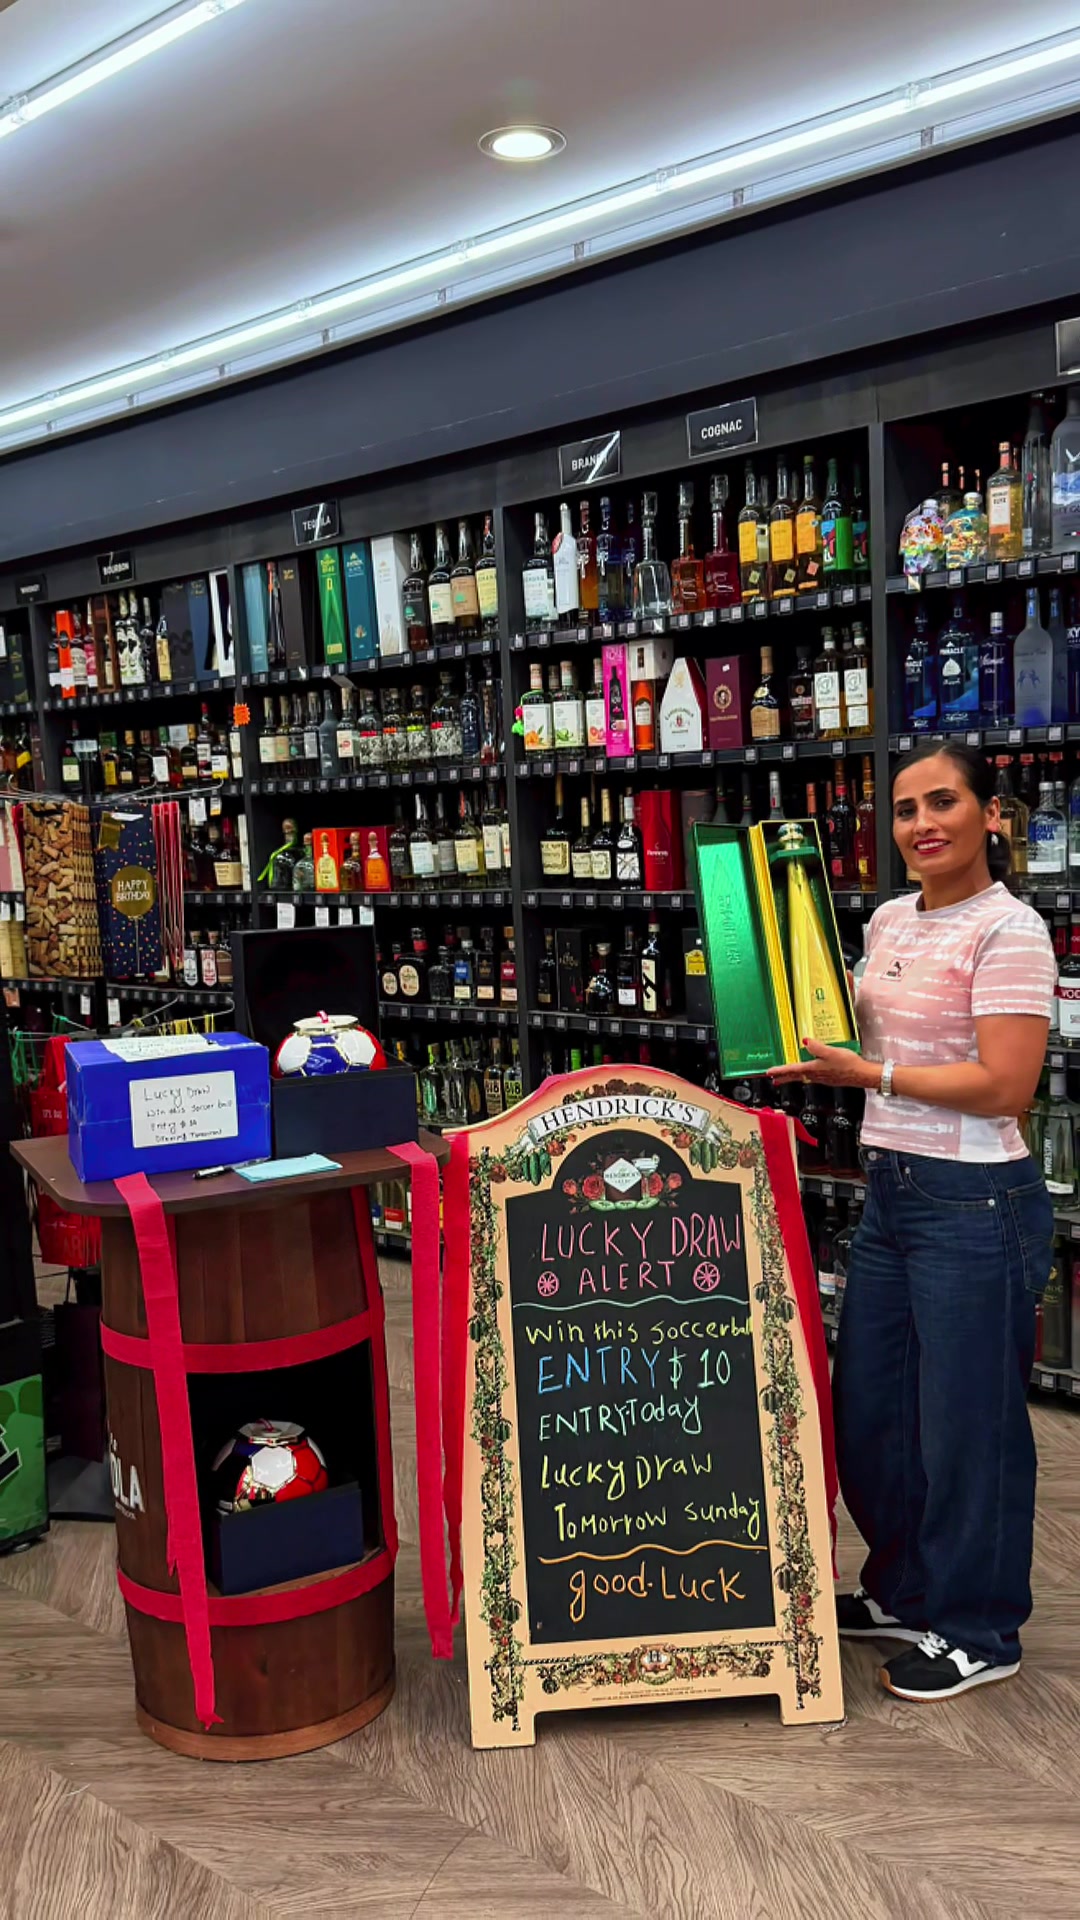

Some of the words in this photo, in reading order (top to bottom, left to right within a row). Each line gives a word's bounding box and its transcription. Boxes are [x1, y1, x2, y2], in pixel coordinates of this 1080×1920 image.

[700, 418, 743, 440] COGNAC
[117, 879, 148, 892] HAPPY
[540, 1098, 698, 1132] HENDRICK'S
[541, 1219, 654, 1262] LUCKY
[671, 1212, 741, 1259] DRAW
[578, 1260, 676, 1296] ALERT
[593, 1319, 639, 1343] this
[537, 1346, 660, 1395] ENTRY
